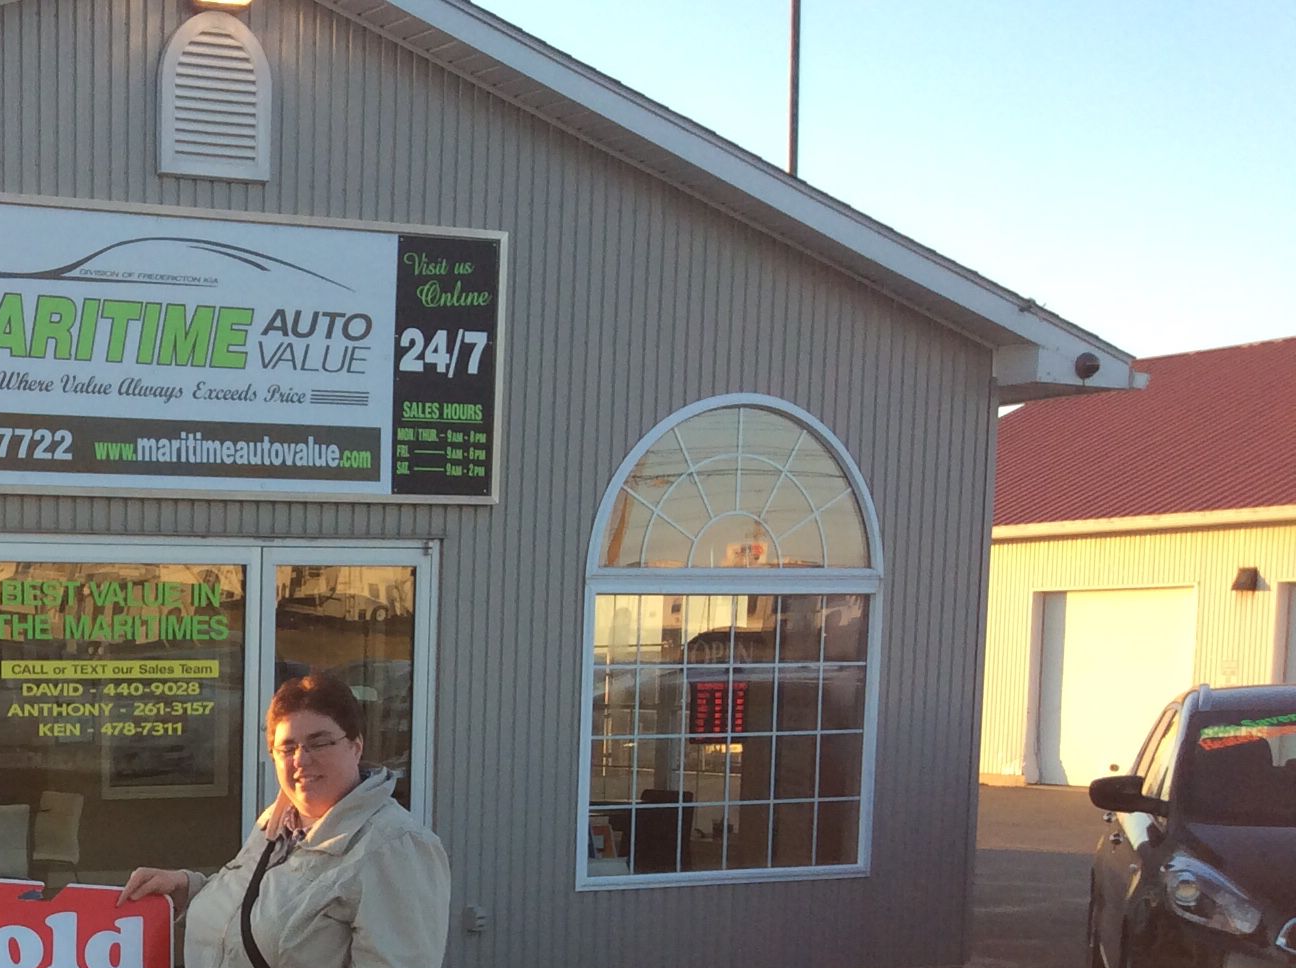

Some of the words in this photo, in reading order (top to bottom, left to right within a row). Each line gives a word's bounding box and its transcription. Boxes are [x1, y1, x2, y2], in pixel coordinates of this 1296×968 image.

[79, 268, 119, 278] DIVISION
[122, 271, 135, 279] OF
[137, 272, 201, 283] FREDERICTON
[403, 252, 449, 276] Visit
[454, 262, 475, 275] us
[416, 280, 493, 308] Online
[260, 308, 373, 342] AUTO
[258, 340, 371, 374] VALUE
[399, 327, 488, 378] 24/7
[60, 374, 113, 396] Value
[118, 376, 183, 404] Always
[192, 381, 257, 402] Exceeds
[264, 384, 306, 405] Price
[402, 401, 440, 419] SALES
[444, 402, 483, 420] HOURS
[94, 431, 371, 469] www.maritimeautovalue.com
[1, 579, 81, 607] BEST
[89, 580, 183, 607] VALUE
[192, 581, 221, 608] IN
[65, 614, 229, 641] MARITIMES
[11, 663, 49, 675] CALL
[52, 666, 67, 675] or
[72, 664, 107, 675] TEXT
[112, 665, 134, 675] our
[139, 663, 175, 675] Sales
[179, 663, 213, 675] Team
[21, 682, 83, 697] DAVID
[103, 682, 200, 695] 440-9028
[7, 703, 114, 717] ANTHONY
[133, 701, 215, 716] 261-3157
[38, 722, 81, 736] KEN
[100, 722, 183, 736] 478-7311
